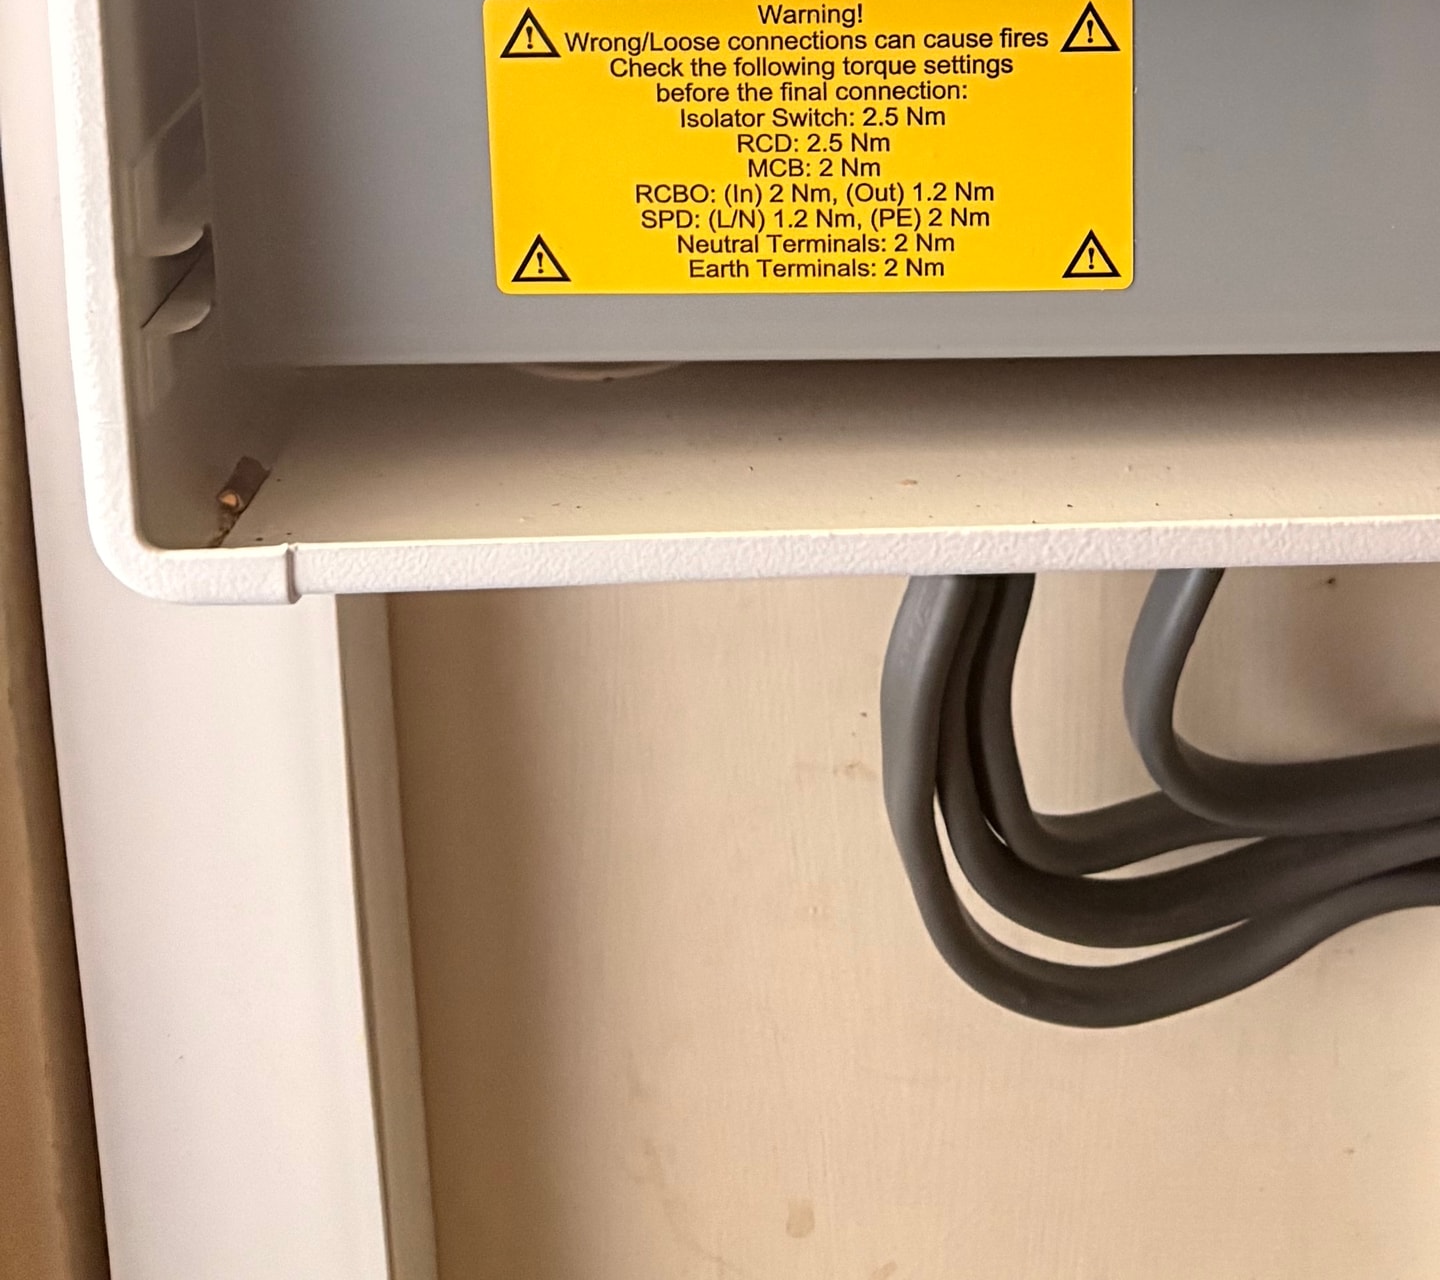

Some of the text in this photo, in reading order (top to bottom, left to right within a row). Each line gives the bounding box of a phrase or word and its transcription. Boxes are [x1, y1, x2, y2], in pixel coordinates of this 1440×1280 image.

[757, 3, 863, 29] Warning!
[564, 27, 1049, 57] Wrong/Loose connections can cause fires
[610, 53, 1014, 81] Check the following torque settings
[656, 80, 968, 103] before the final connection:
[680, 106, 946, 128] Isolator Switch: 2.5 Nm
[737, 132, 890, 153] RCD: 2.5 Nm
[748, 157, 881, 178] MCB: 2 Nm
[635, 181, 994, 208] RCBO: (In) 2 Nm, (Out) 1.2 Nm
[641, 207, 990, 234] SPD: (L/N) 1.2 Nm, (PE) 2 Nm
[677, 232, 955, 254] Neutral Terminals: 2 Nm
[689, 257, 945, 278] Earth Terminals: 2 Nm
